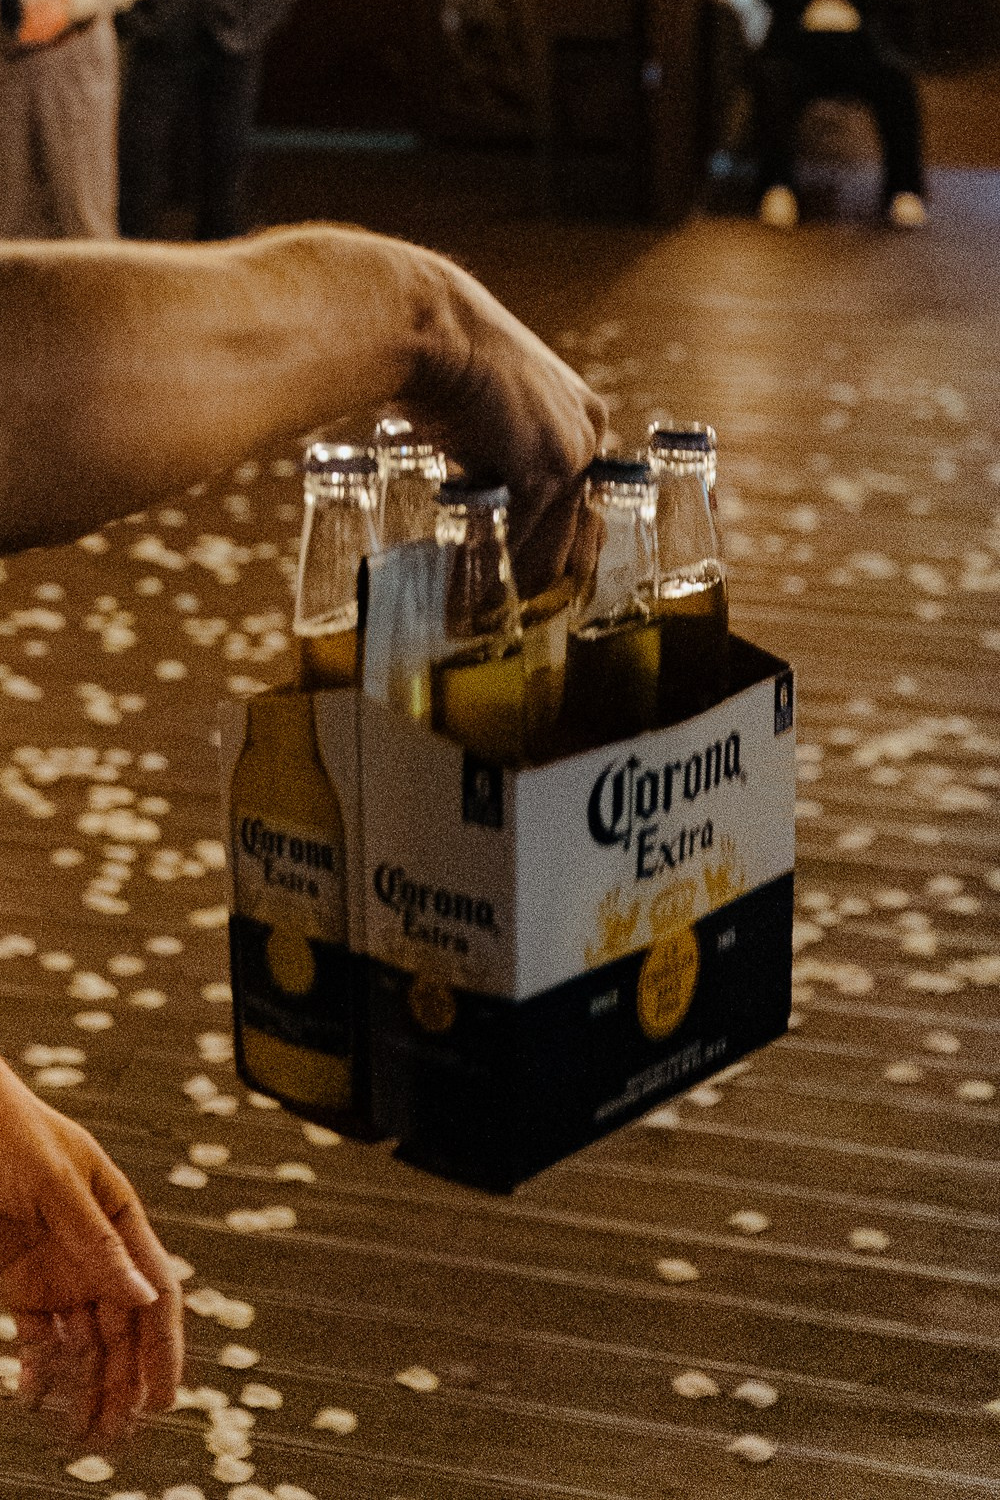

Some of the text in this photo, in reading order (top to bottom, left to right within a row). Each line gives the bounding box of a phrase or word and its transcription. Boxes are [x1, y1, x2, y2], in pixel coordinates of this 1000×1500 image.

[587, 731, 741, 852] Corona
[636, 817, 714, 880] Extra
[373, 861, 494, 928] Corona
